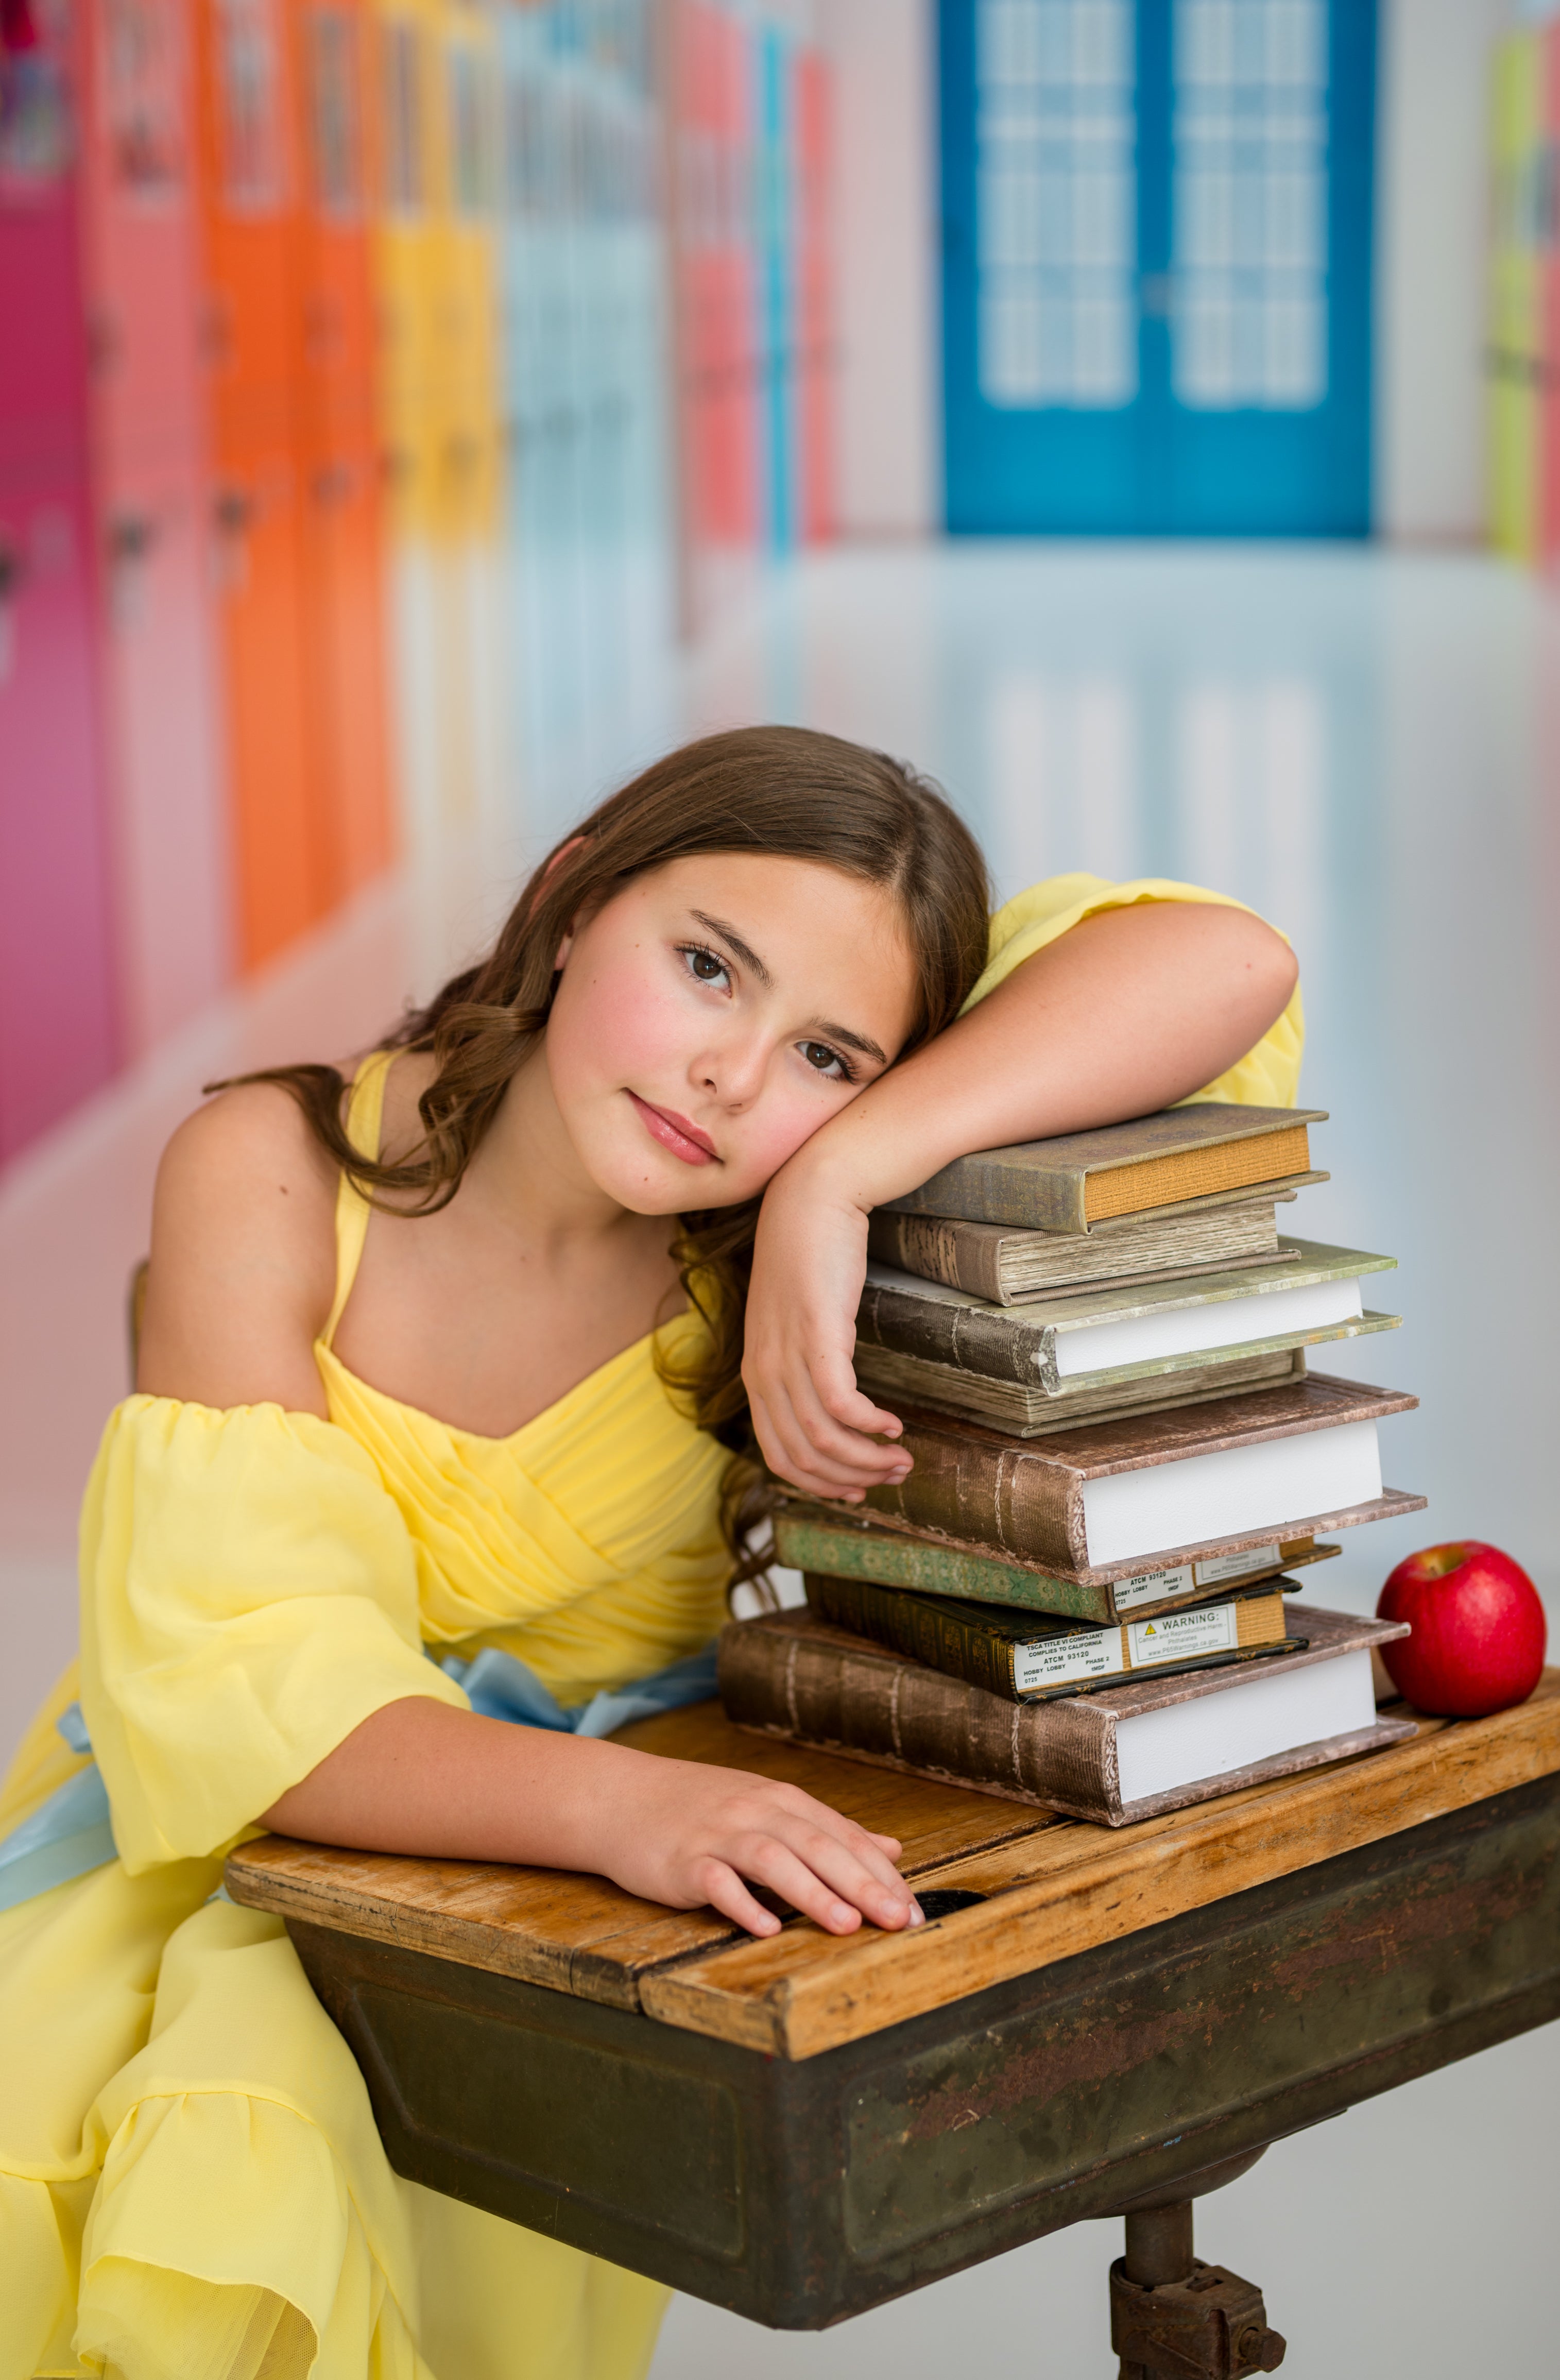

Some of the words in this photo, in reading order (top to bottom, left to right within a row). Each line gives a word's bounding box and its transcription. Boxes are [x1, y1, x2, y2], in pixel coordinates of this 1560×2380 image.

[1130, 1576, 1146, 1586] ATCM
[1150, 1571, 1166, 1580] 93120
[1115, 1589, 1130, 1597] HOBBY
[1162, 1612, 1219, 1630] WARNING:
[1069, 1633, 1104, 1643] COMPLIANT
[1138, 1635, 1158, 1643] Cancer
[1171, 1625, 1206, 1637] Reproductive
[1028, 1648, 1057, 1657] COMPLIES
[1068, 1640, 1102, 1650] CALIFORNIA
[1044, 1656, 1064, 1664] ATCM
[1068, 1651, 1089, 1660] 93120
[1024, 1668, 1043, 1676] HOBBY
